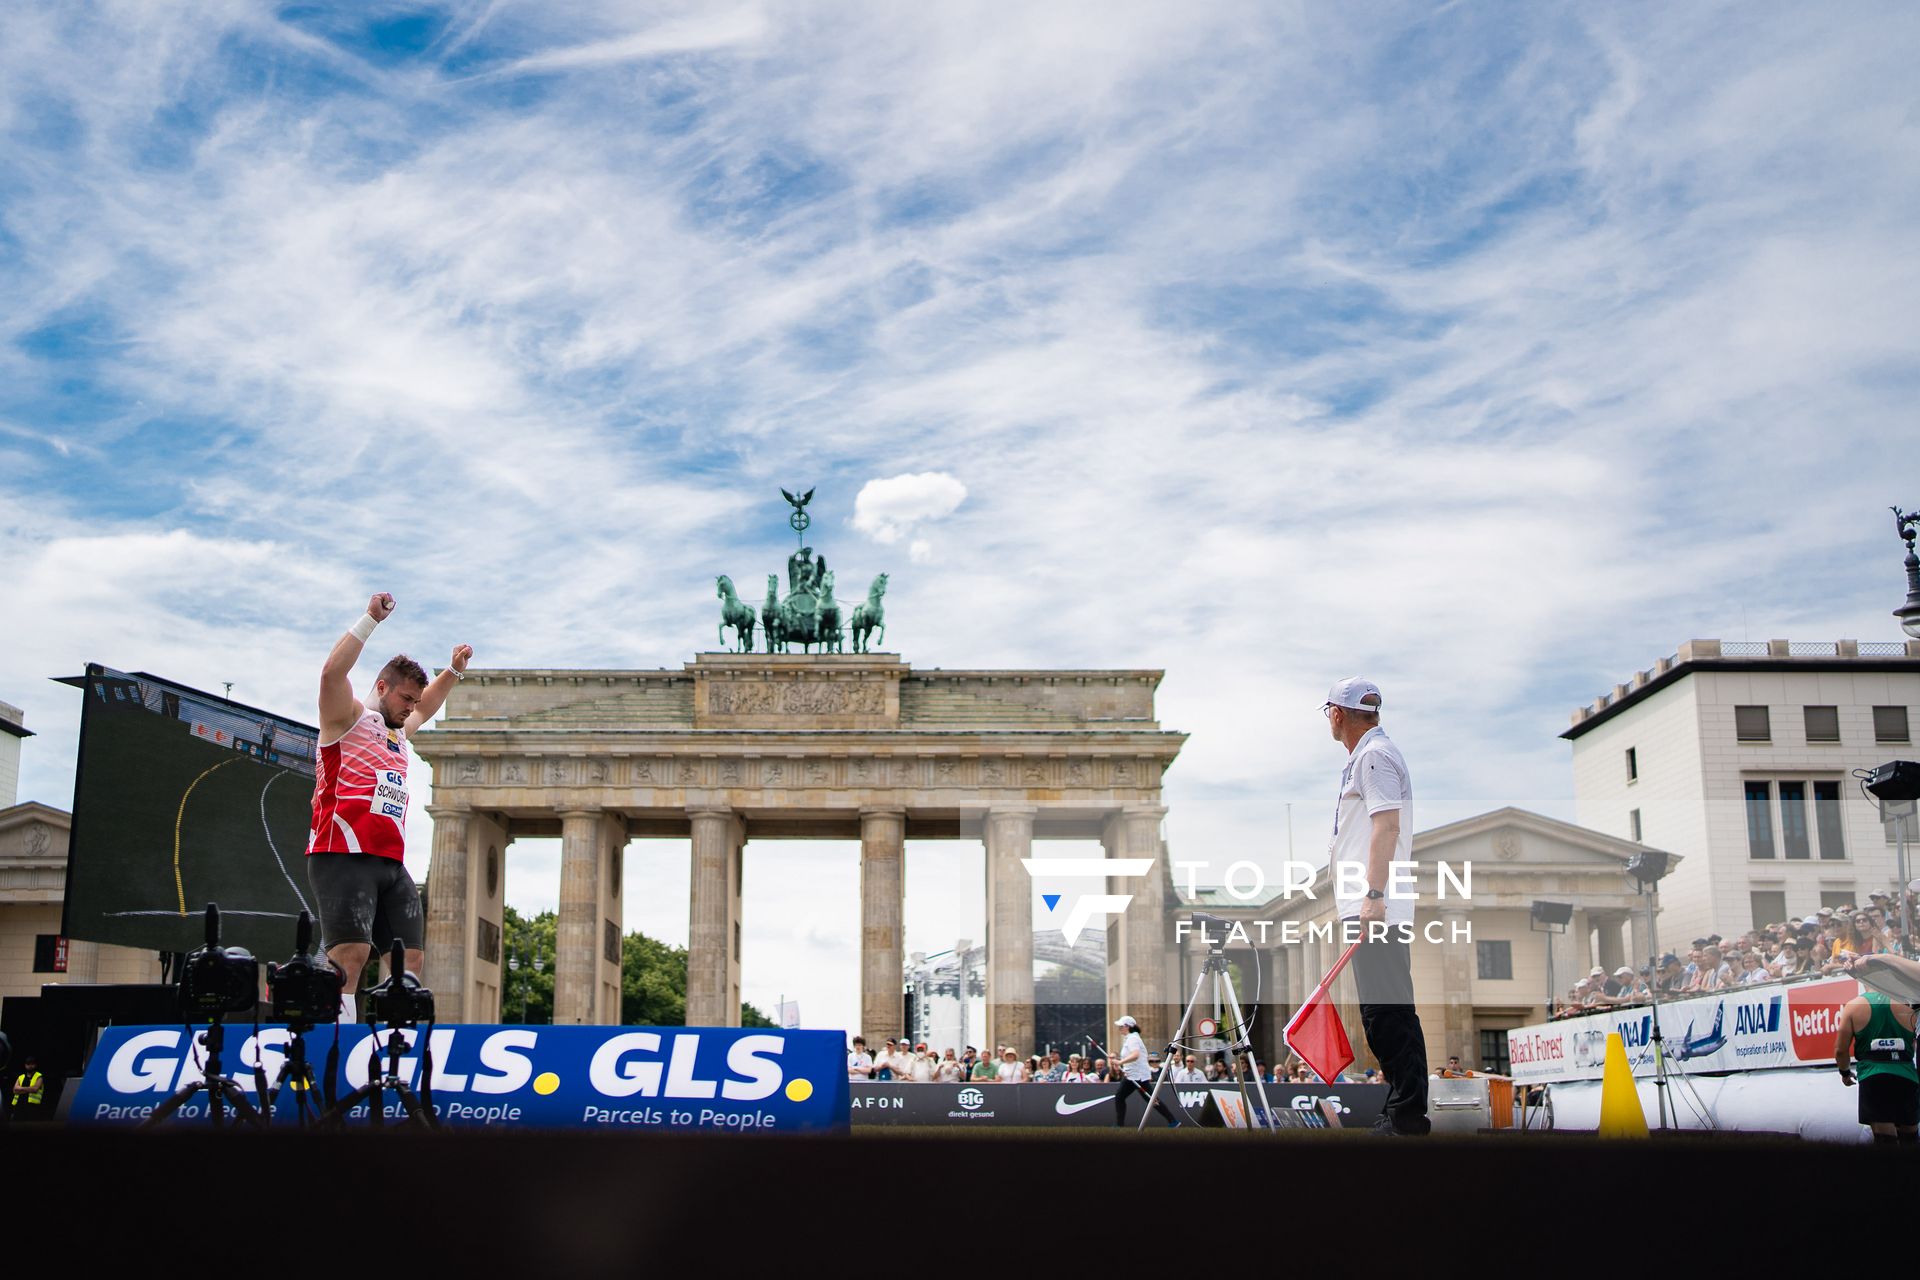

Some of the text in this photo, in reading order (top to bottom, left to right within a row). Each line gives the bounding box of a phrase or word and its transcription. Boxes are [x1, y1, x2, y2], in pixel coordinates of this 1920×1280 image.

[387, 772, 402, 786] GLS
[1735, 1003, 1767, 1036] ANA
[1793, 1005, 1844, 1037] bett1.d
[1510, 1034, 1564, 1065] Black Forest
[95, 1101, 159, 1119] Parce
[177, 1103, 199, 1119] to
[957, 1093, 984, 1105] BIG
[349, 1101, 410, 1118] arels
[447, 1103, 521, 1125] People
[583, 1105, 776, 1132] Parcels to People
[948, 1110, 995, 1119] direkt gesund
